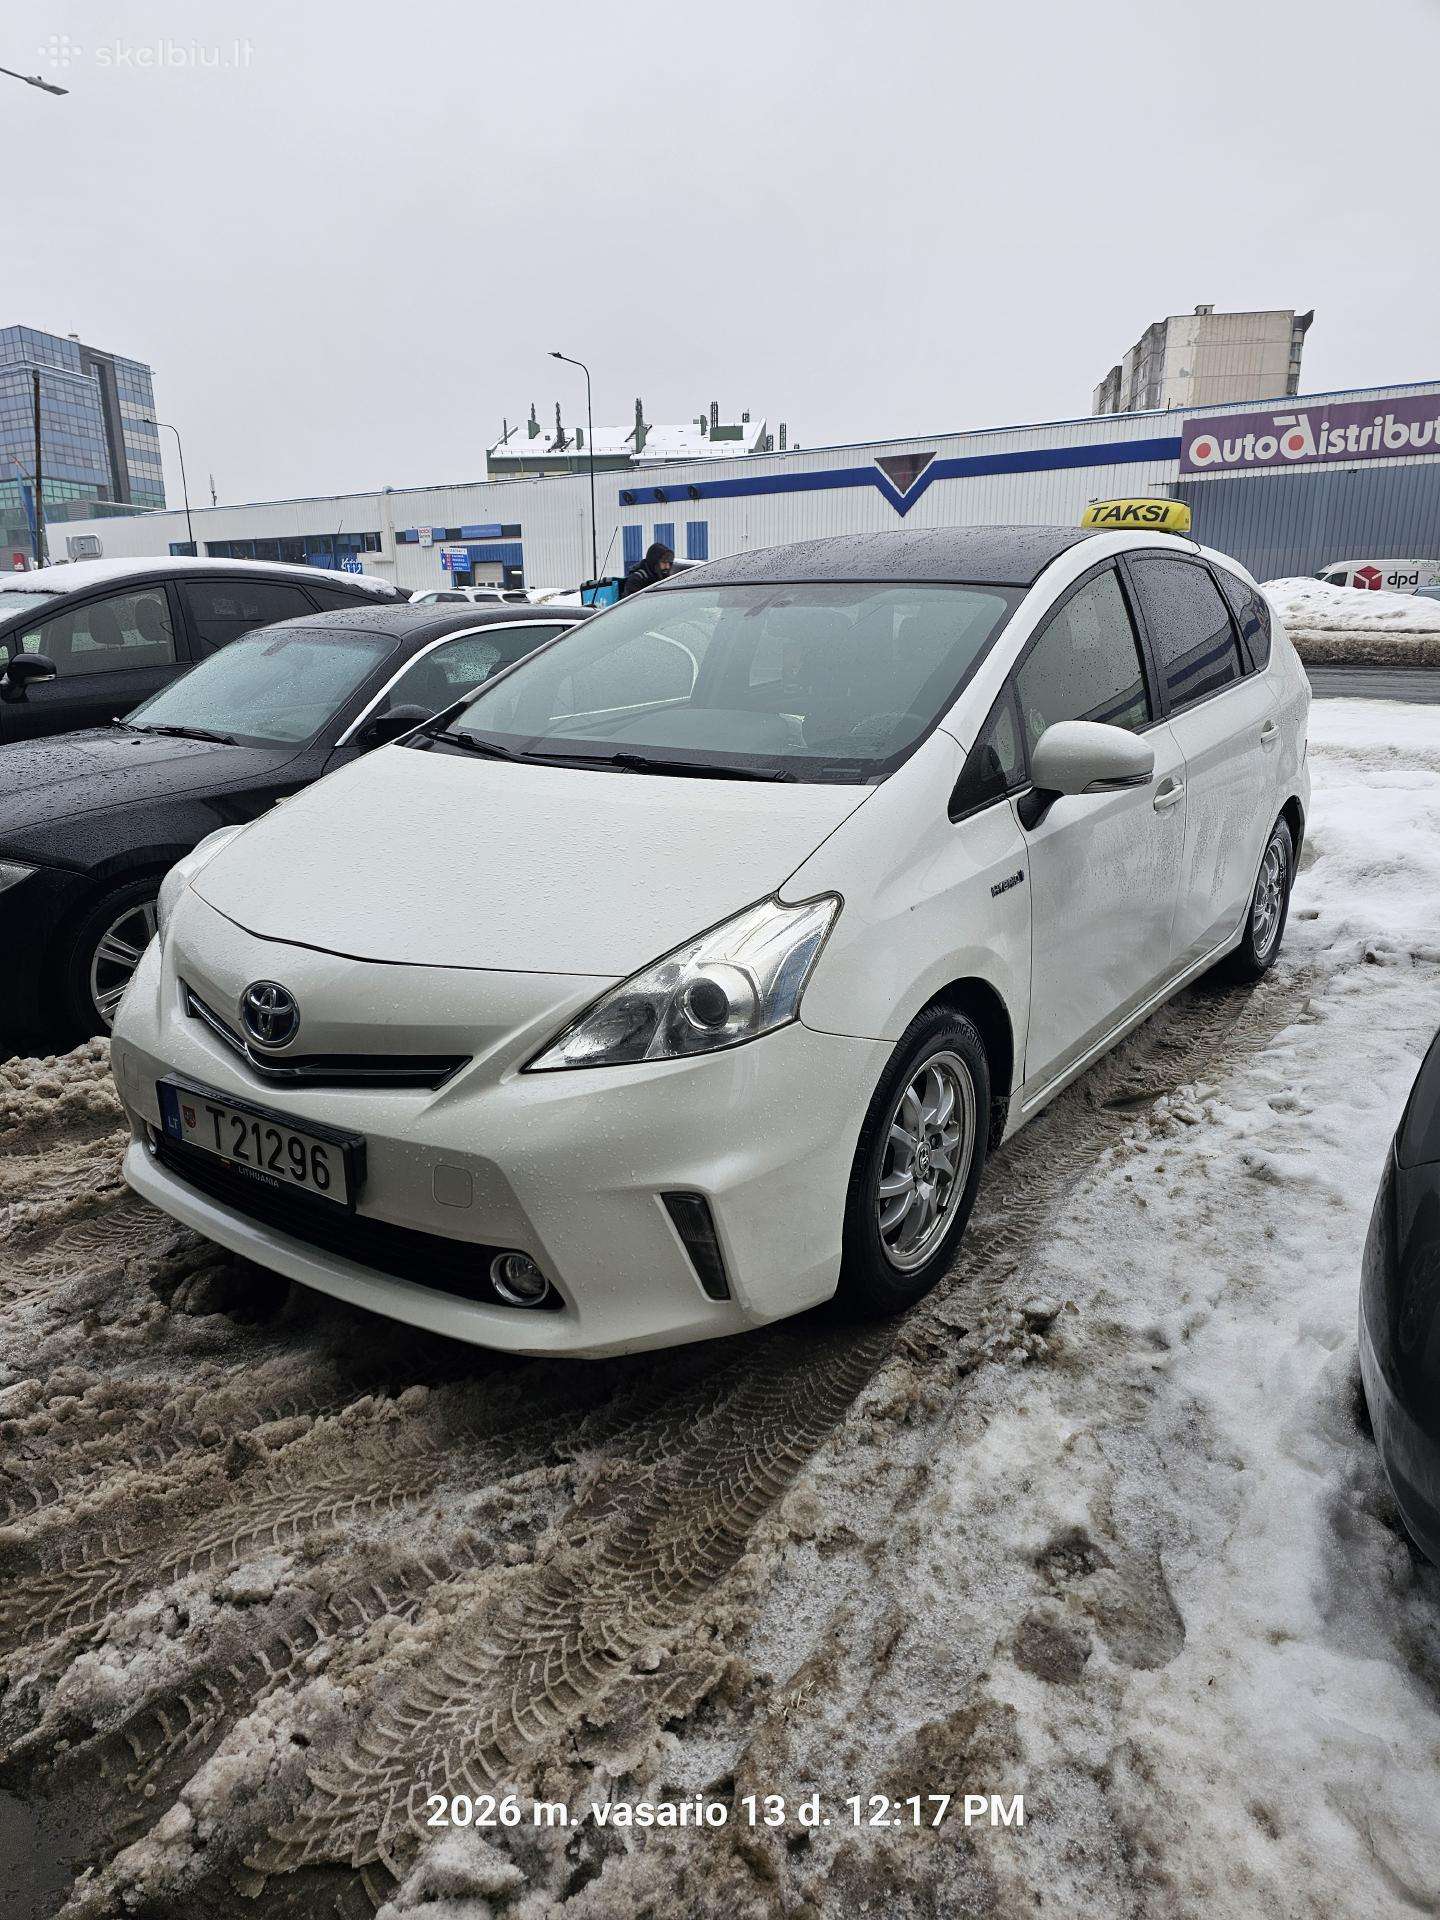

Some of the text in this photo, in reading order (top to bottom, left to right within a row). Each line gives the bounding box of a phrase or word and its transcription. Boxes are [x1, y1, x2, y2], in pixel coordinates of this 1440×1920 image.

[1091, 504, 1170, 523] TAKSI
[1387, 570, 1419, 589] dpd
[168, 1116, 179, 1130] LT
[238, 1165, 280, 1189] LITHUANIA
